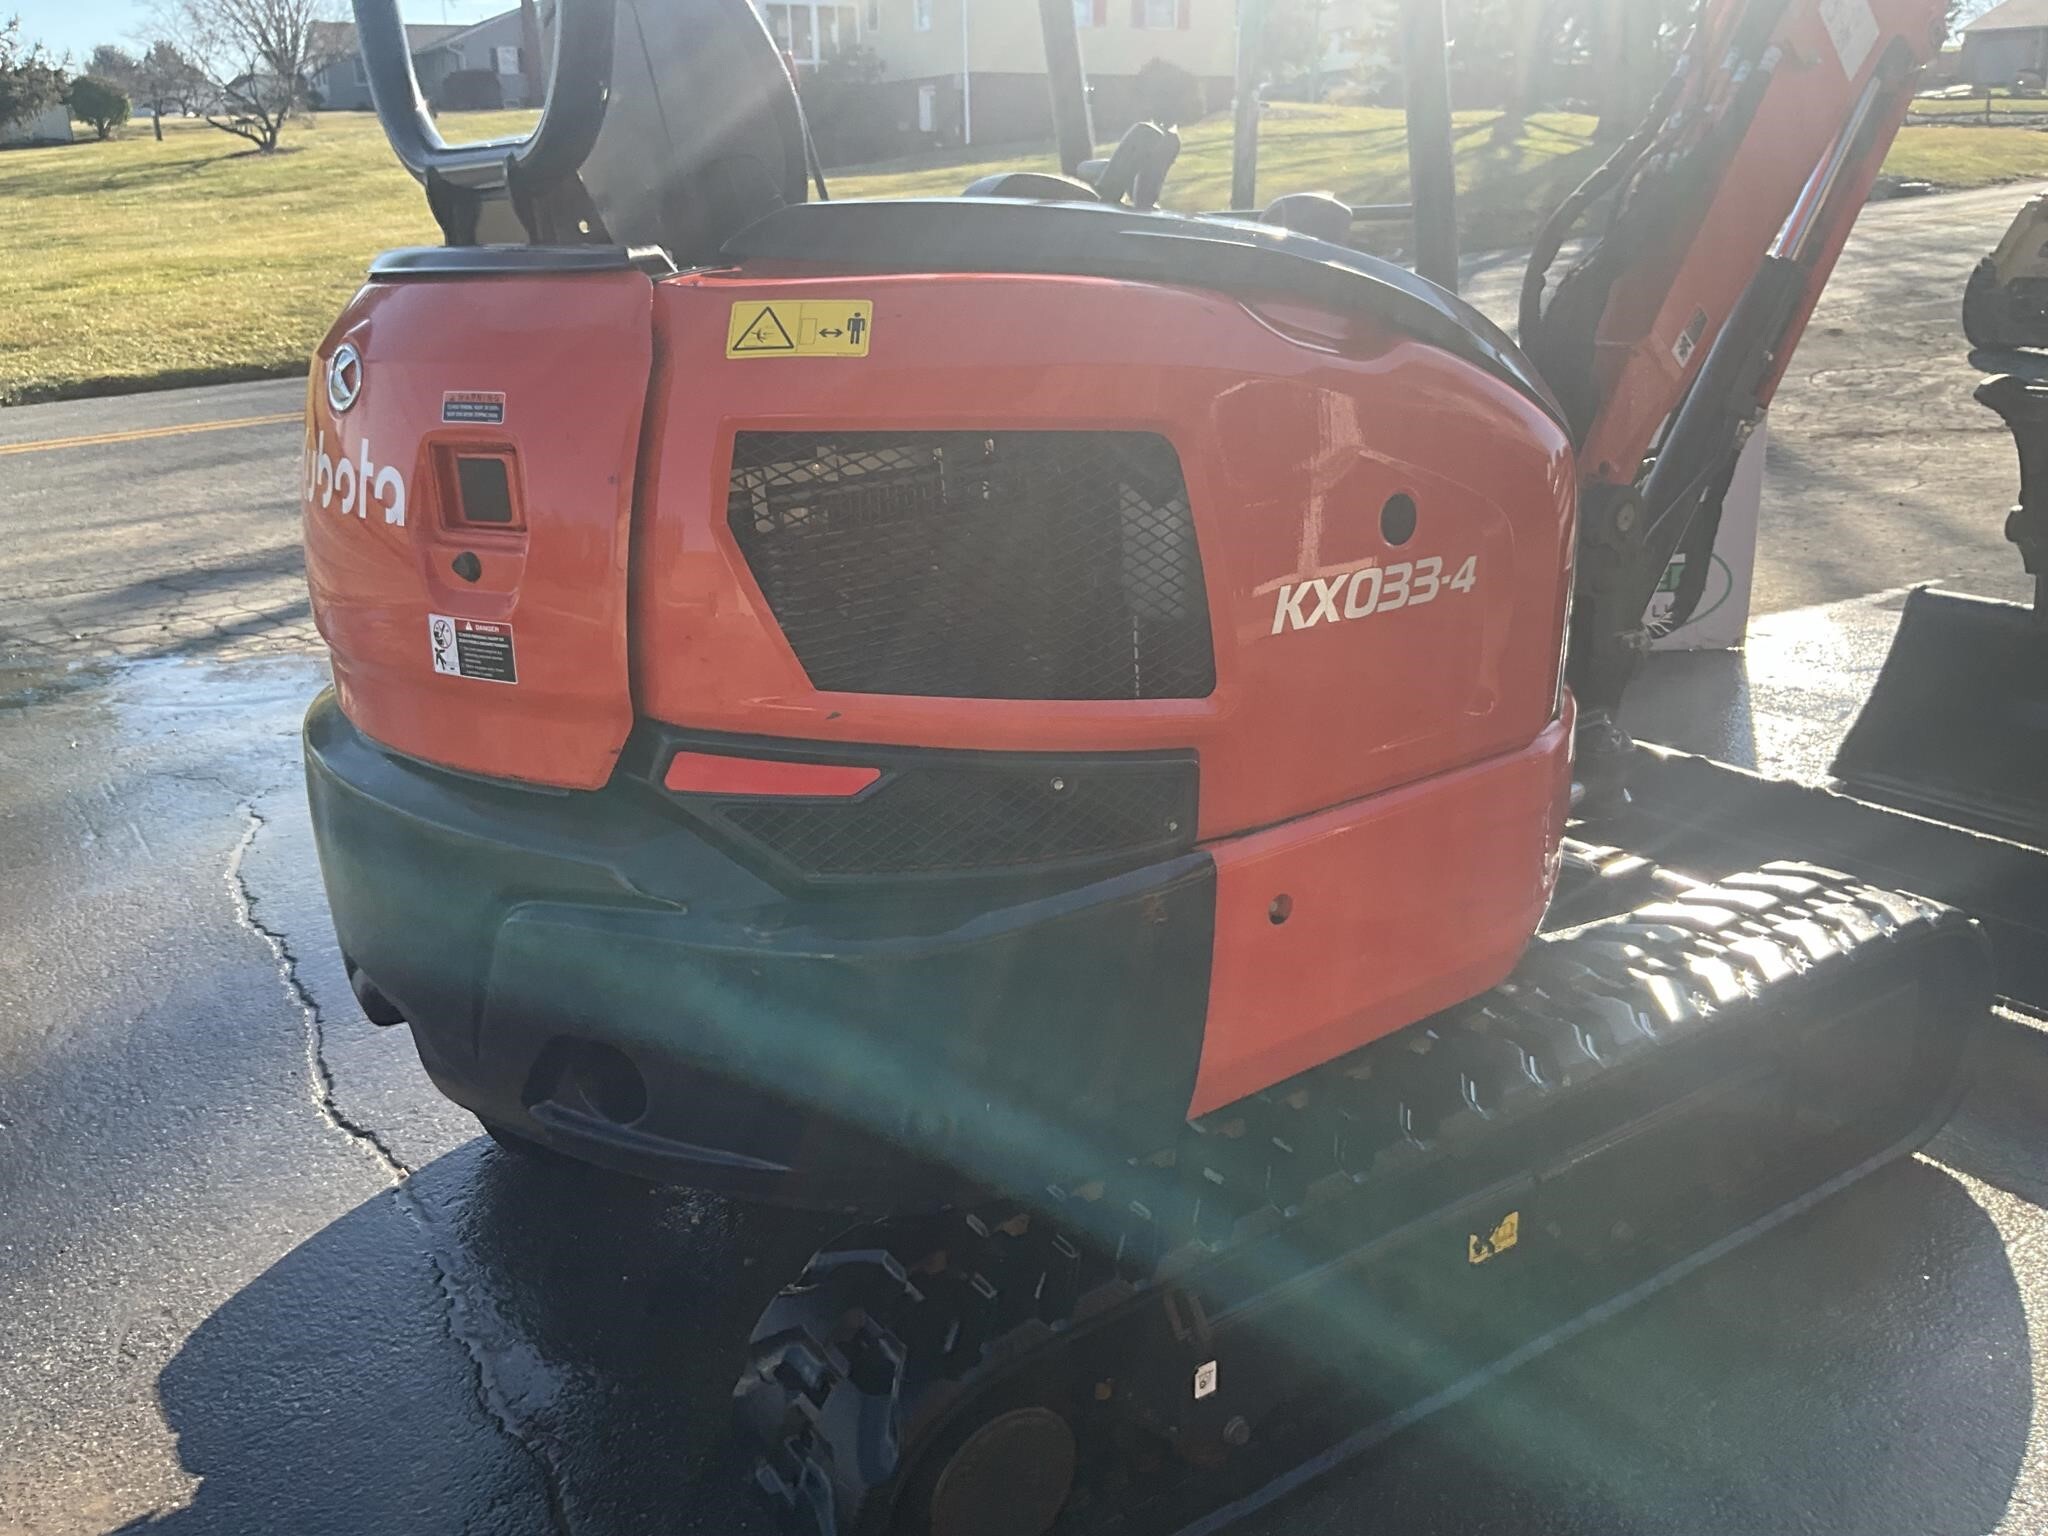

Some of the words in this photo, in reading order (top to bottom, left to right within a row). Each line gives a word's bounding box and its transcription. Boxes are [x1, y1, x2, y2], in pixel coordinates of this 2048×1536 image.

[304, 427, 405, 527] ubota
[475, 624, 500, 633] DANGER
[1271, 555, 1478, 635] KX033-4
